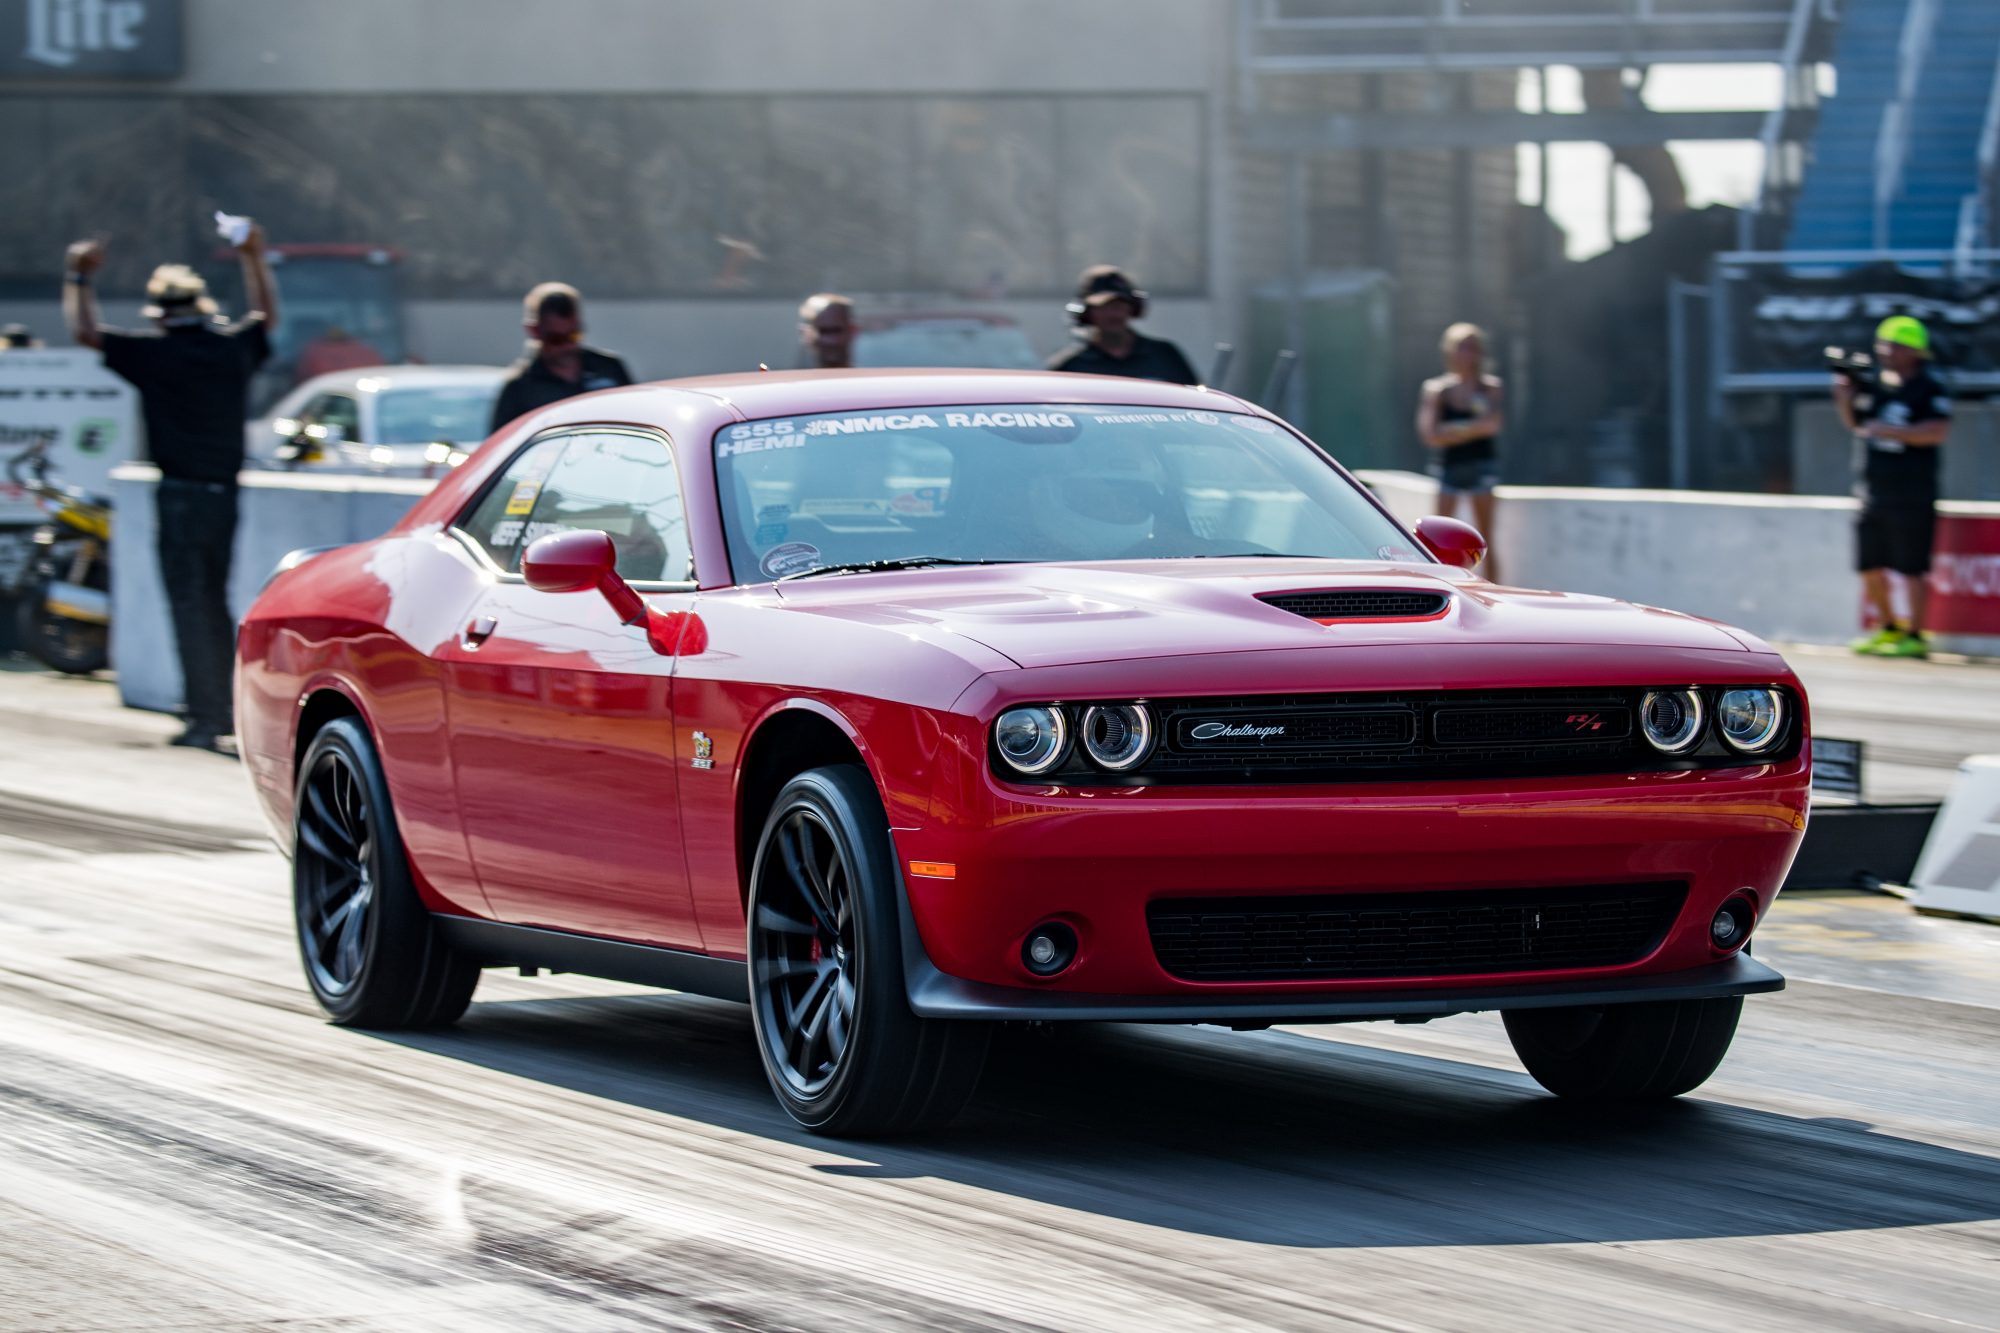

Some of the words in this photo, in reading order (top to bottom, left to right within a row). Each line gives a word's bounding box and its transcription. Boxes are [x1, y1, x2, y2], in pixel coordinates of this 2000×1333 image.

[25, 0, 146, 67] Lite
[825, 415, 939, 436] NMCA
[945, 412, 1075, 428] RACING
[1094, 413, 1169, 425] PRESENTED
[1169, 413, 1188, 424] BY
[730, 421, 795, 440] 555
[717, 434, 807, 458] HEMI
[1190, 722, 1285, 740] Challenger
[1565, 713, 1608, 732] R/T
